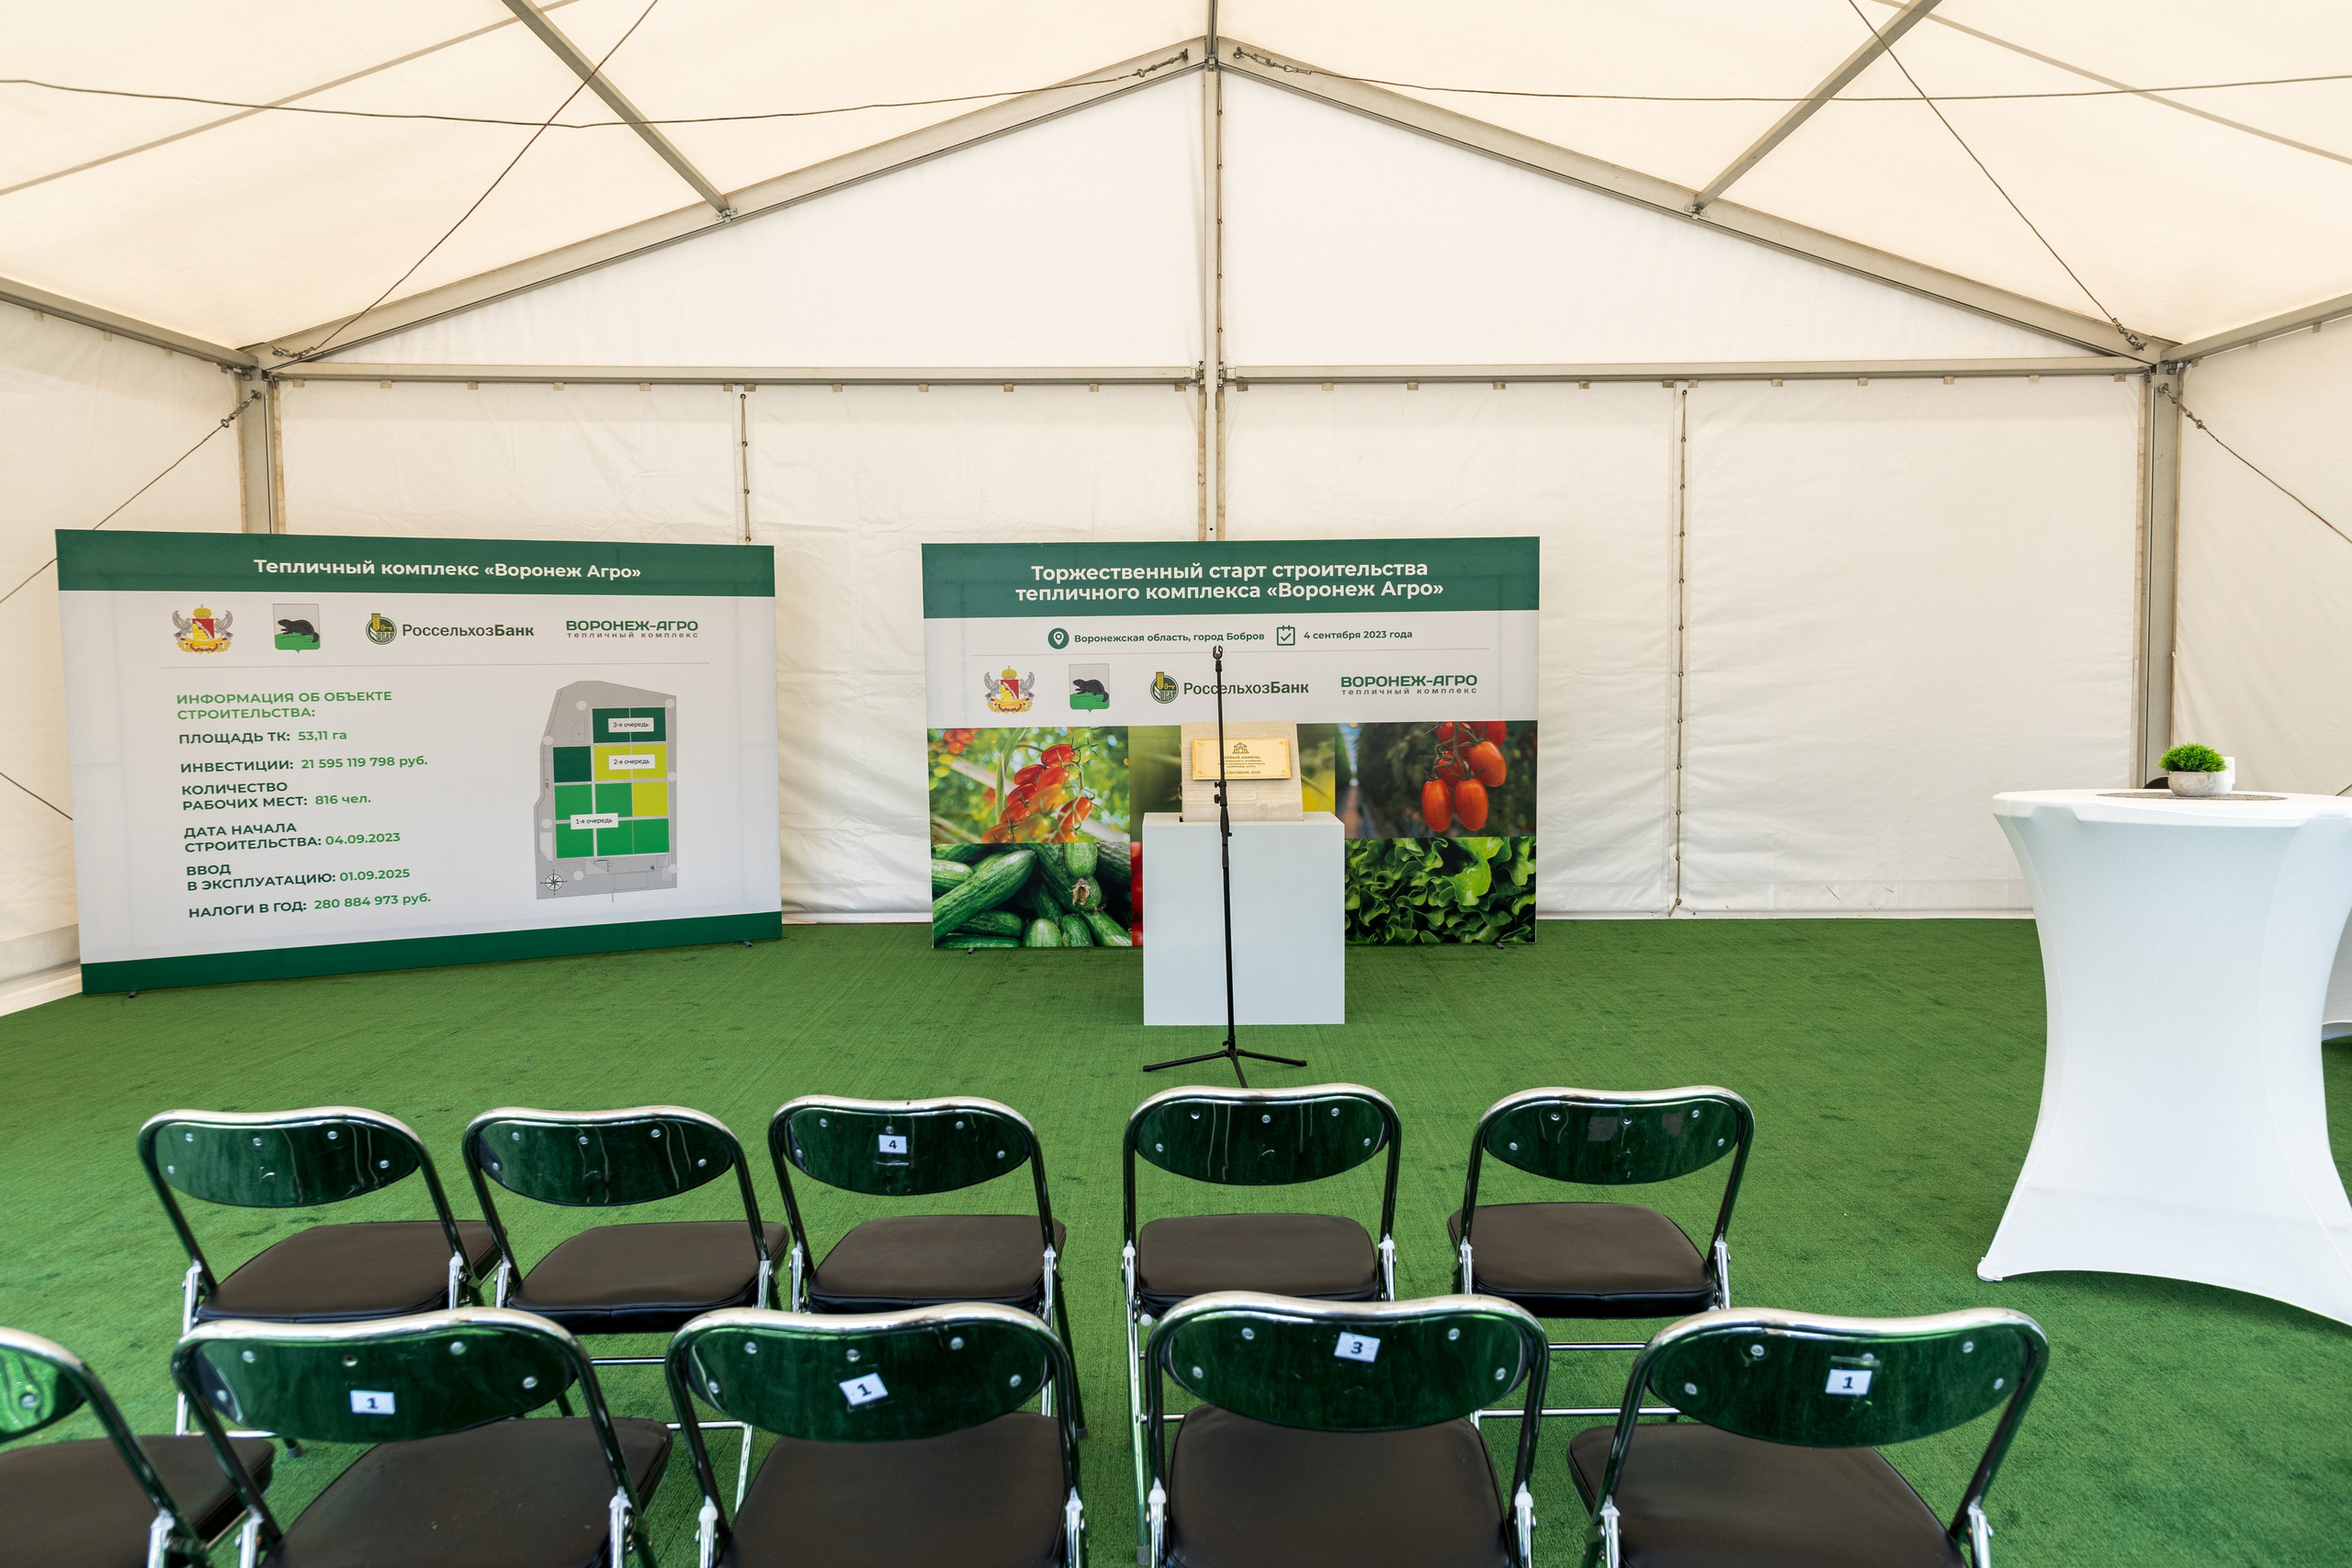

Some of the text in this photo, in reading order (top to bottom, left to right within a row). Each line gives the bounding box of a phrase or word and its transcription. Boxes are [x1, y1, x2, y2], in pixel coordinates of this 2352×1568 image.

[254, 558, 641, 581] Тепличный комплекс «Воронеж Агро»
[1031, 561, 1429, 584] Торжественный старт строительства
[1015, 581, 1443, 602] тепличного комплекса «Воронеж Агро»
[402, 624, 535, 637] РоссельхозБанк
[566, 620, 698, 631] ВОРОНЕЖ-АГРО
[1074, 631, 1265, 644] Воронежская область, город Бобров
[1304, 630, 1413, 641] 4 сентября 2023 года
[1340, 675, 1477, 687] ВОРОНЕЖ-АГРО
[1341, 687, 1410, 695] тепличный
[176, 691, 392, 705] ИНФОРМАЦИЯ ОБ ОБЪЕКТЕ
[177, 707, 315, 720] СТРОИТЕЛЬСТВА:
[179, 730, 347, 745] ПЛОЩАДЬ ТК: 53,11 га
[180, 755, 428, 773] ИНВЕСТИЦИИ: 21 595 119 798 руб.
[181, 782, 288, 795] КОЛИЧЕСТВО
[183, 794, 371, 811] РАБОЧИХ МЕСТ: 816 чел.
[184, 823, 297, 840] ДАТА НАЧАЛА
[185, 832, 401, 852] СТРОИТЕЛЬСТВА: 04.09.2023
[187, 863, 232, 876] ВВОД
[187, 868, 410, 891] В ЭКСПЛУАТАЦИЮ: 01.09.2025
[189, 892, 431, 919] НАЛОГИ В ГОД: 280 884 973 руб.
[889, 1140, 898, 1149] 4
[1351, 1341, 1363, 1354] 3
[1842, 1376, 1853, 1389] 1
[857, 1383, 872, 1396] 1
[367, 1397, 379, 1409] 1
